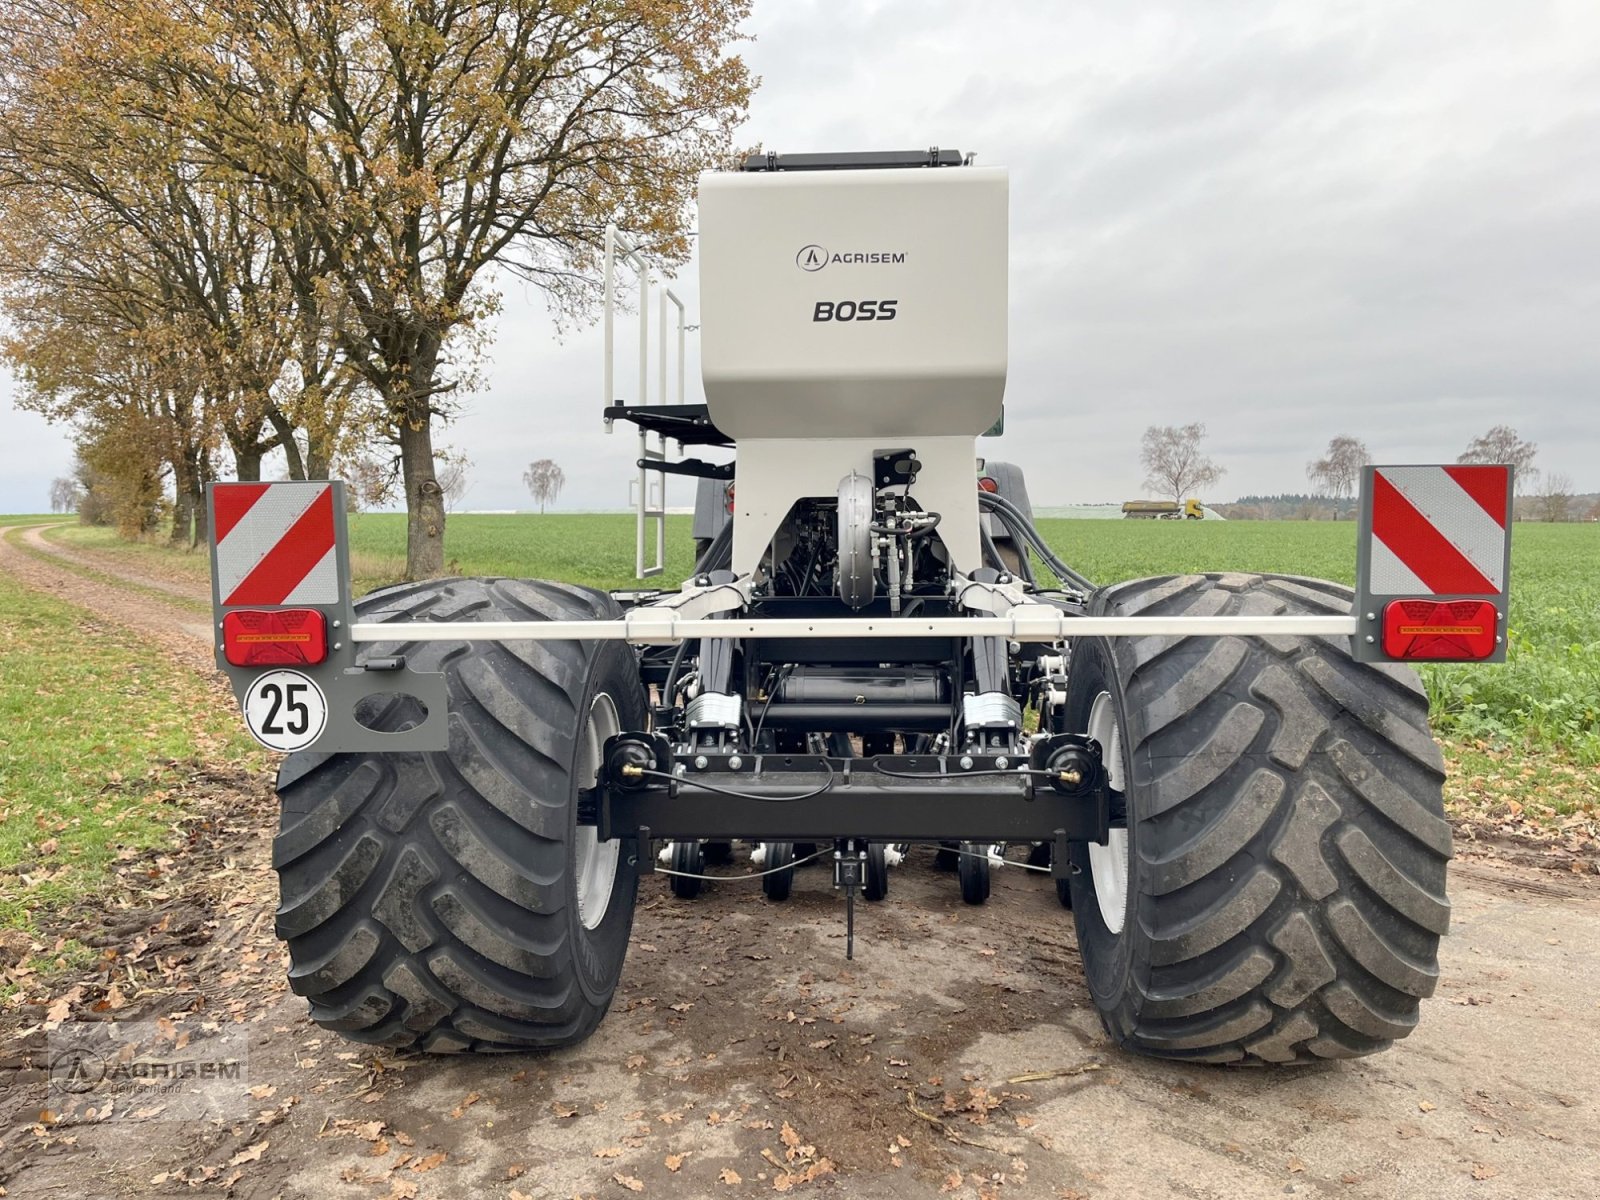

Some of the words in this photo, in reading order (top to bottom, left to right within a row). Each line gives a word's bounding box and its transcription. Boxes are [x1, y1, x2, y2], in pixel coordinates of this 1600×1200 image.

[831, 253, 905, 264] AGRISEM
[812, 300, 898, 322] BOSS
[260, 683, 309, 735] 25
